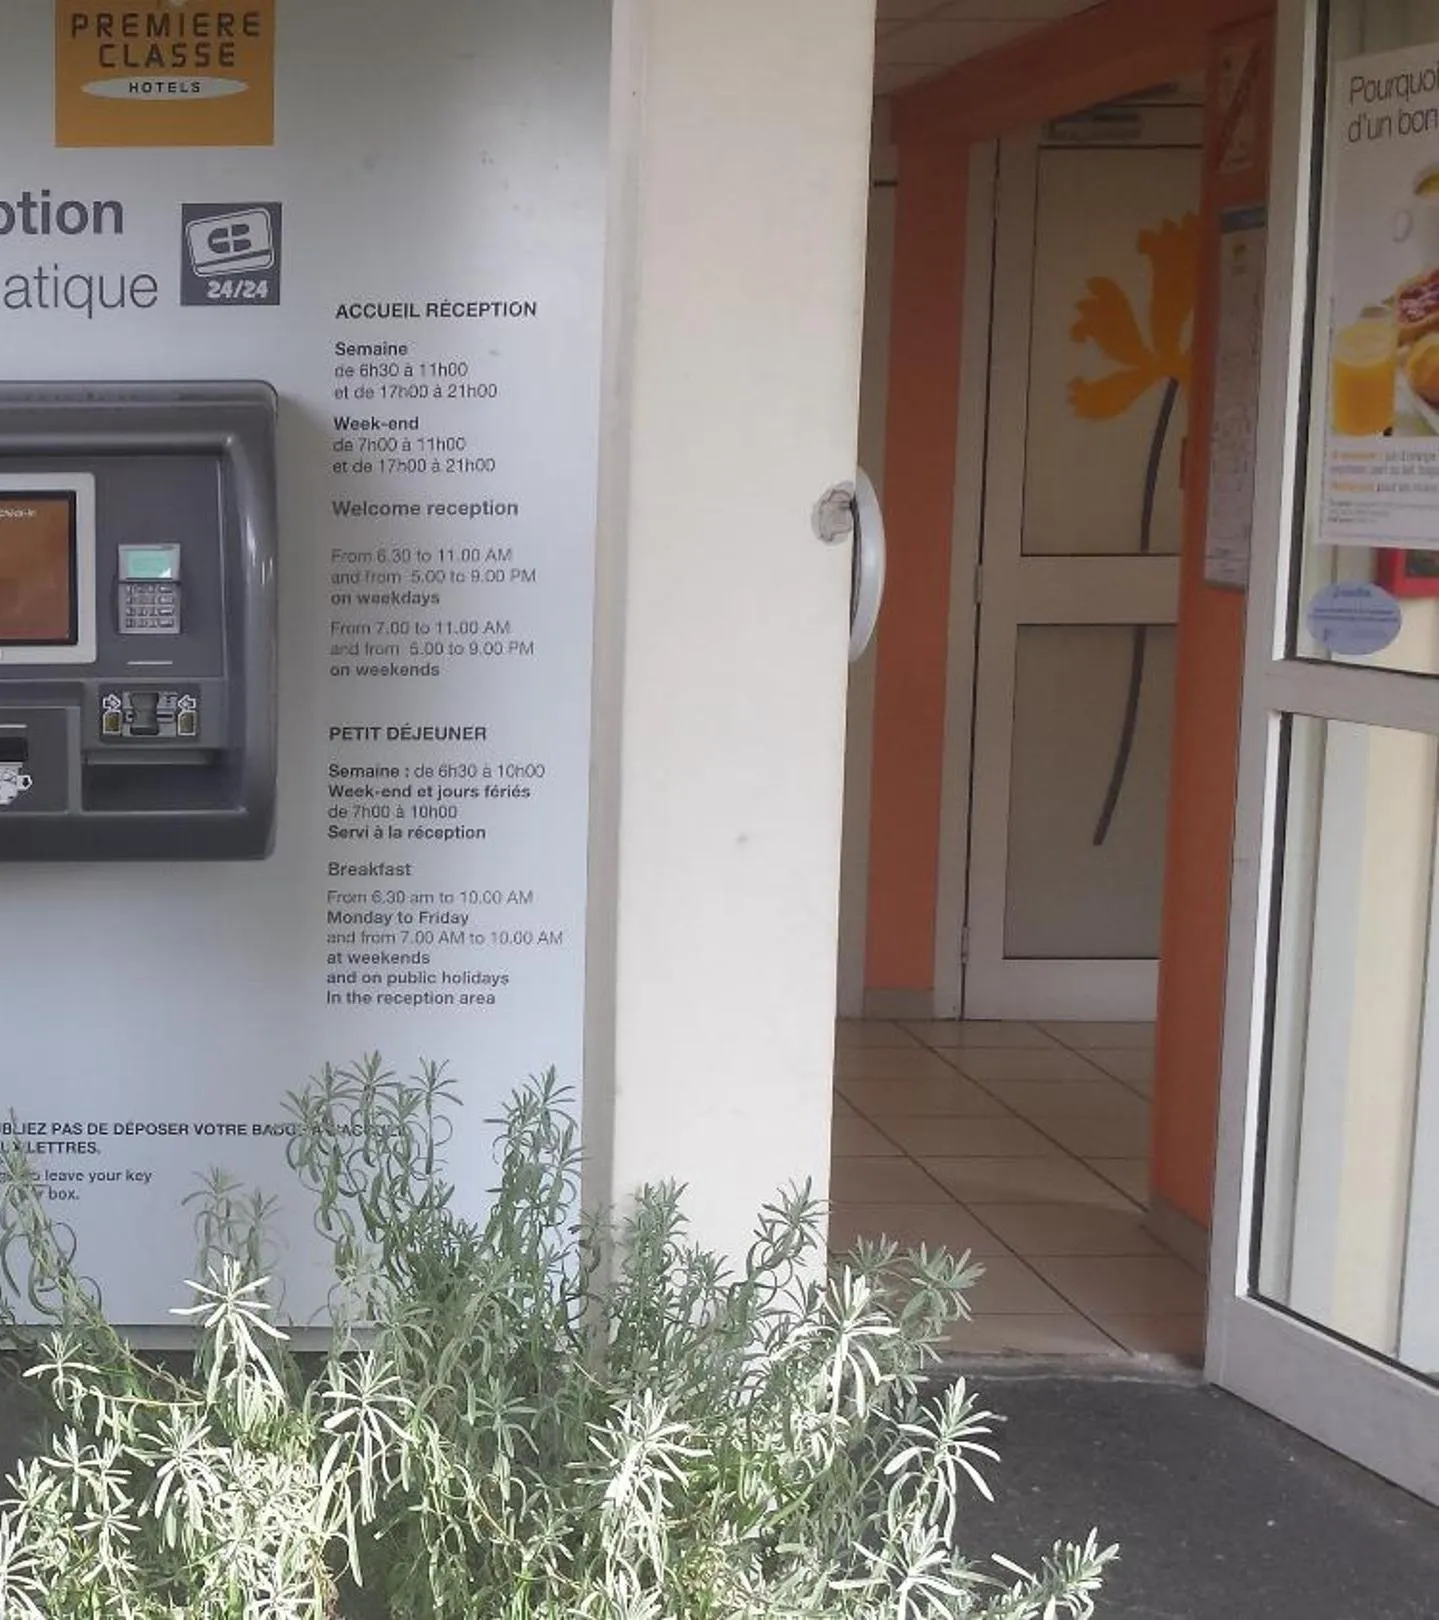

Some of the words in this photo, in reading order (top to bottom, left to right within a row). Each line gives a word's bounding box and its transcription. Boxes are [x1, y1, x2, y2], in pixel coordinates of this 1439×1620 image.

[71, 12, 260, 38] PREMIERE
[99, 42, 236, 68] CLASSE
[128, 81, 201, 94] HOTELS
[1348, 113, 1392, 143] d'un
[1399, 108, 1438, 135] bon
[207, 280, 269, 298] 24/24
[335, 303, 420, 319] ACCUEIL
[426, 300, 537, 317] RÉCEPTION
[335, 342, 408, 356] Semaine
[335, 365, 354, 377] de
[360, 363, 398, 377] 6h30
[420, 362, 468, 377] 11h00
[335, 385, 349, 398] et
[354, 385, 374, 398] de
[380, 385, 428, 398] 17h00
[448, 384, 497, 398] 21h00
[334, 417, 419, 431] Week-end
[333, 438, 352, 451] de
[359, 437, 397, 451] 7h00
[417, 437, 466, 451] 11h00
[333, 460, 346, 473] et
[352, 460, 372, 473] de
[379, 459, 427, 472] 17h00
[446, 458, 495, 472] 21h00
[332, 501, 420, 517] Welcome
[427, 500, 518, 518] reception
[331, 549, 371, 563] From
[417, 550, 431, 562] to
[485, 548, 512, 562] AM
[331, 571, 359, 585] and
[365, 571, 401, 584] from
[510, 569, 537, 583] PM
[331, 592, 351, 605] on
[357, 591, 440, 607] weekdays
[330, 622, 370, 635] From
[415, 621, 429, 634] to
[448, 642, 463, 655] to
[508, 641, 534, 655] PM
[330, 664, 350, 677] on
[356, 663, 440, 676] weekends
[329, 727, 381, 740] PETIT
[387, 723, 487, 740] DÉJEUNER
[328, 765, 399, 778] Semaine
[414, 765, 434, 778] de
[438, 765, 476, 778] 6h30
[498, 765, 545, 778] 10h00
[328, 785, 411, 798] Week-end
[417, 785, 432, 798] et
[437, 785, 479, 800] jours
[484, 784, 531, 798] fériés
[328, 805, 347, 818] de
[352, 805, 390, 818] 7h00
[412, 805, 457, 818] 10h00
[328, 826, 368, 839] Servi
[374, 825, 383, 839] à
[389, 825, 402, 838] la
[407, 825, 486, 841] réception
[328, 862, 412, 877] Breakfast
[327, 891, 367, 904] From
[410, 893, 434, 904] am
[439, 891, 454, 904] to
[460, 890, 502, 904] 10.00
[506, 890, 533, 904] AM
[327, 911, 392, 927] Monday
[397, 911, 413, 924] to
[419, 911, 469, 927] Friday
[327, 931, 355, 945] and
[361, 931, 395, 945] from
[438, 931, 465, 945] AM
[470, 931, 485, 945] to
[537, 931, 562, 945] AM
[327, 952, 342, 964] at
[348, 951, 430, 964] weekends
[327, 972, 356, 984] and
[361, 972, 382, 984] on
[387, 971, 436, 987] public
[442, 971, 509, 987] holidays
[346, 992, 372, 1004] the
[377, 991, 454, 1007] reception
[459, 993, 495, 1005] area
[52, 1122, 84, 1135] PAS
[88, 1122, 108, 1135] DE
[113, 1119, 188, 1135] DÉPOSER
[193, 1122, 247, 1135] VOTRE
[253, 1122, 304, 1135] BADG
[45, 1169, 83, 1181] leave
[89, 1172, 122, 1184] your
[126, 1169, 152, 1185] key
[49, 1188, 79, 1200] box.
